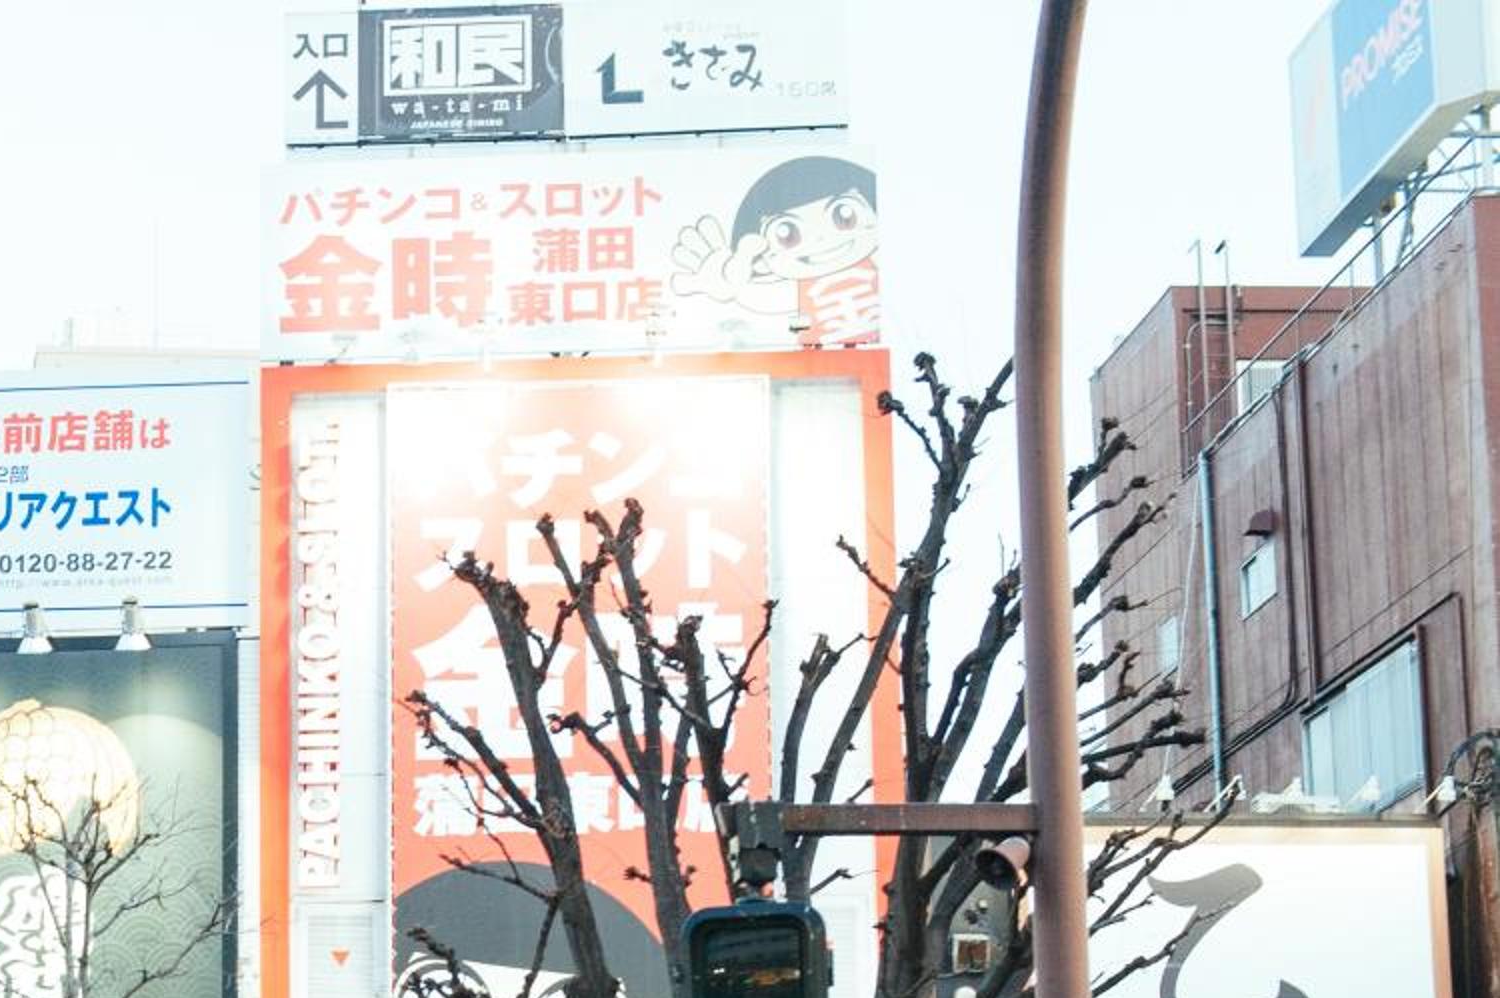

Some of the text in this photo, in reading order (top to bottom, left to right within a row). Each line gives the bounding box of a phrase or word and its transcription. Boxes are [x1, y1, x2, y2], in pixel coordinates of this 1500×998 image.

[292, 33, 349, 59] 入口
[389, 21, 526, 90] 和民
[390, 94, 524, 118] wa-ta-mi
[531, 226, 635, 274] 蒲田
[278, 230, 493, 334] 金時
[507, 278, 663, 330] 東口店
